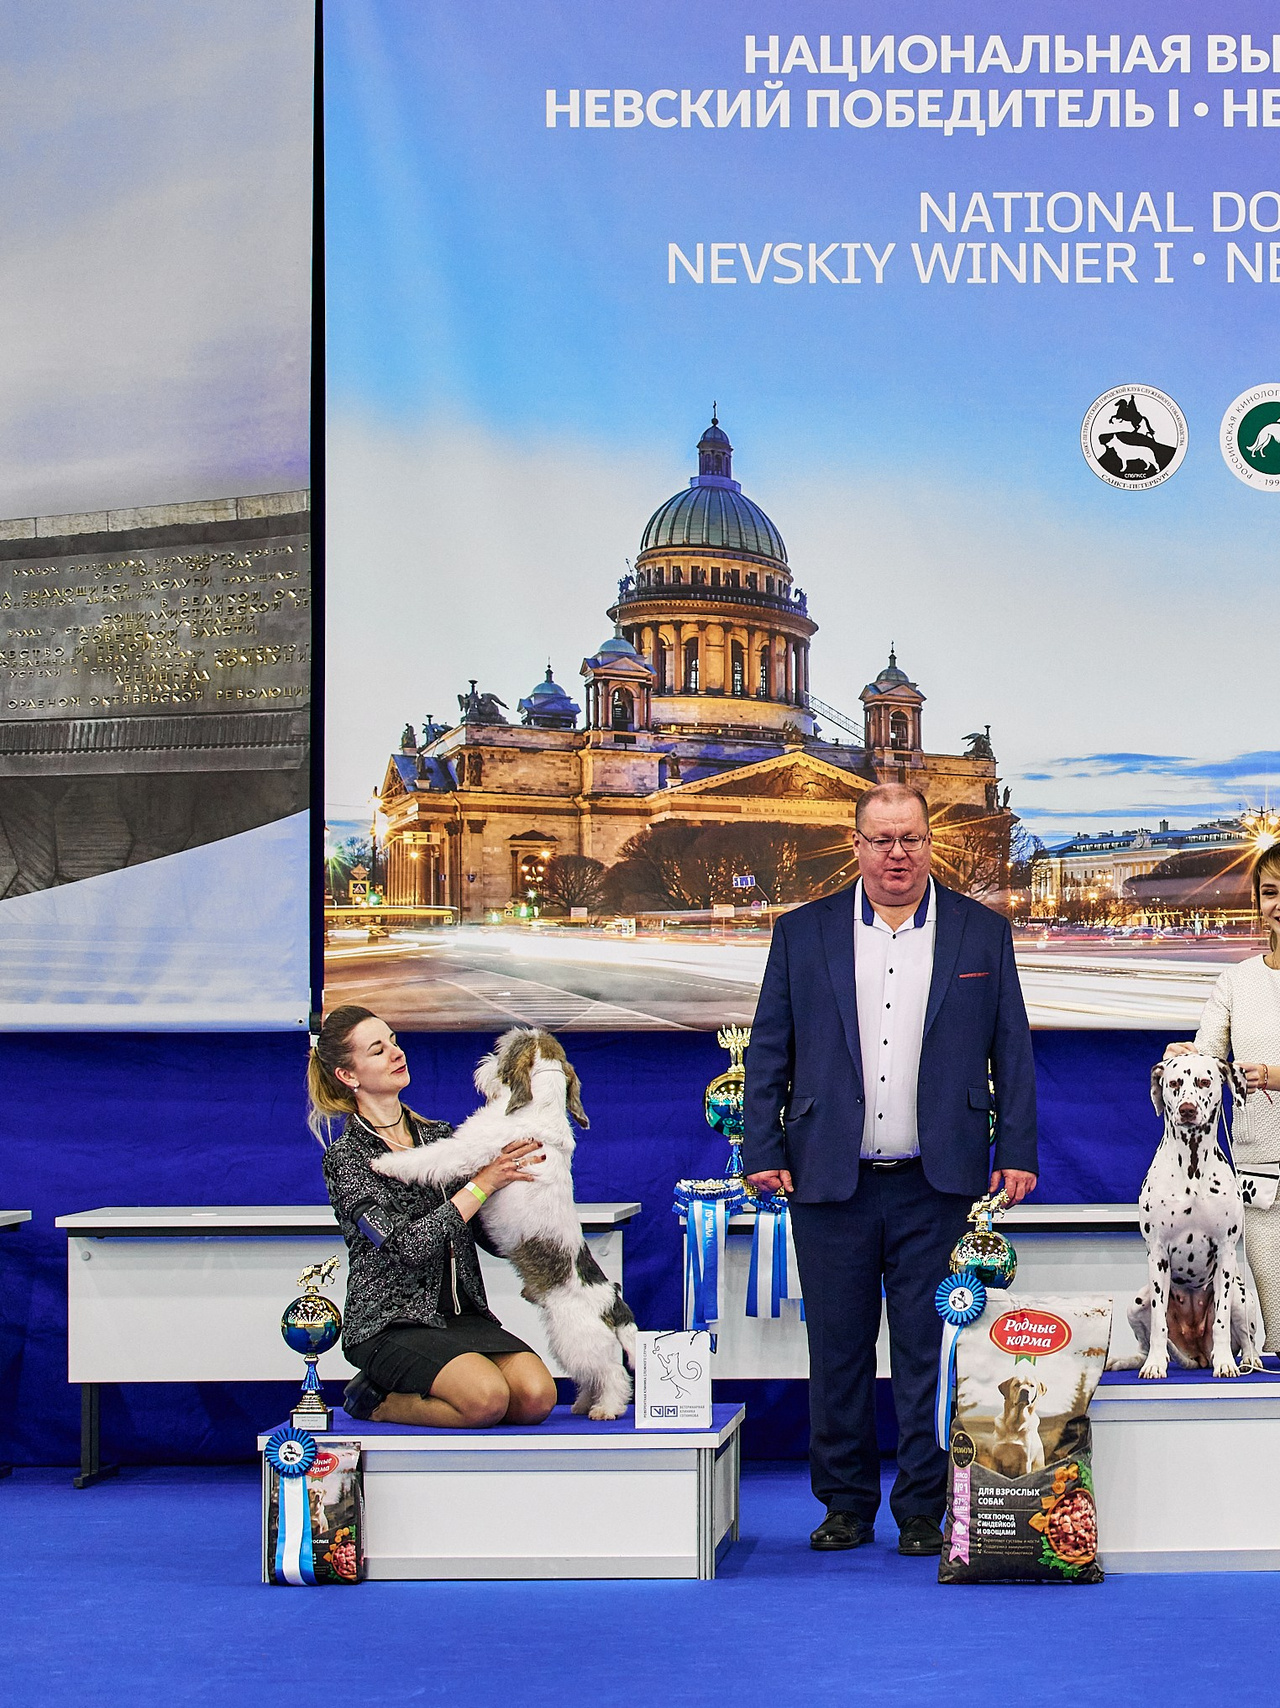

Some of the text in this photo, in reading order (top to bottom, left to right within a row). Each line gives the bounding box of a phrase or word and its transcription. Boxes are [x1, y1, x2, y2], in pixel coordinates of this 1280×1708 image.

[744, 33, 1192, 82] НАЦИОНАЛЬНАЯ
[545, 80, 790, 129] НЕВСКИЙ
[806, 88, 1155, 137] ПОБЕДИТЕЛЬ
[1168, 89, 1180, 128] I
[919, 191, 1194, 234] NATIONAL
[667, 242, 896, 285] NEVSKIY
[910, 242, 1139, 284] WINNER
[1153, 242, 1174, 283] I
[1225, 415, 1254, 480] РОССИЙСКАЯ
[274, 587, 311, 600] ОКТ
[215, 652, 311, 669] КОММУНИ
[1003, 1316, 1058, 1336] Родные
[1006, 1332, 1052, 1349] корма
[978, 1487, 1041, 1497] ДЛЯ ВЗРОСЛЫХ
[978, 1497, 1005, 1506] СОБАК
[992, 1513, 1015, 1521] ПОРОД
[982, 1528, 1016, 1536] ОВОЩАМИ
